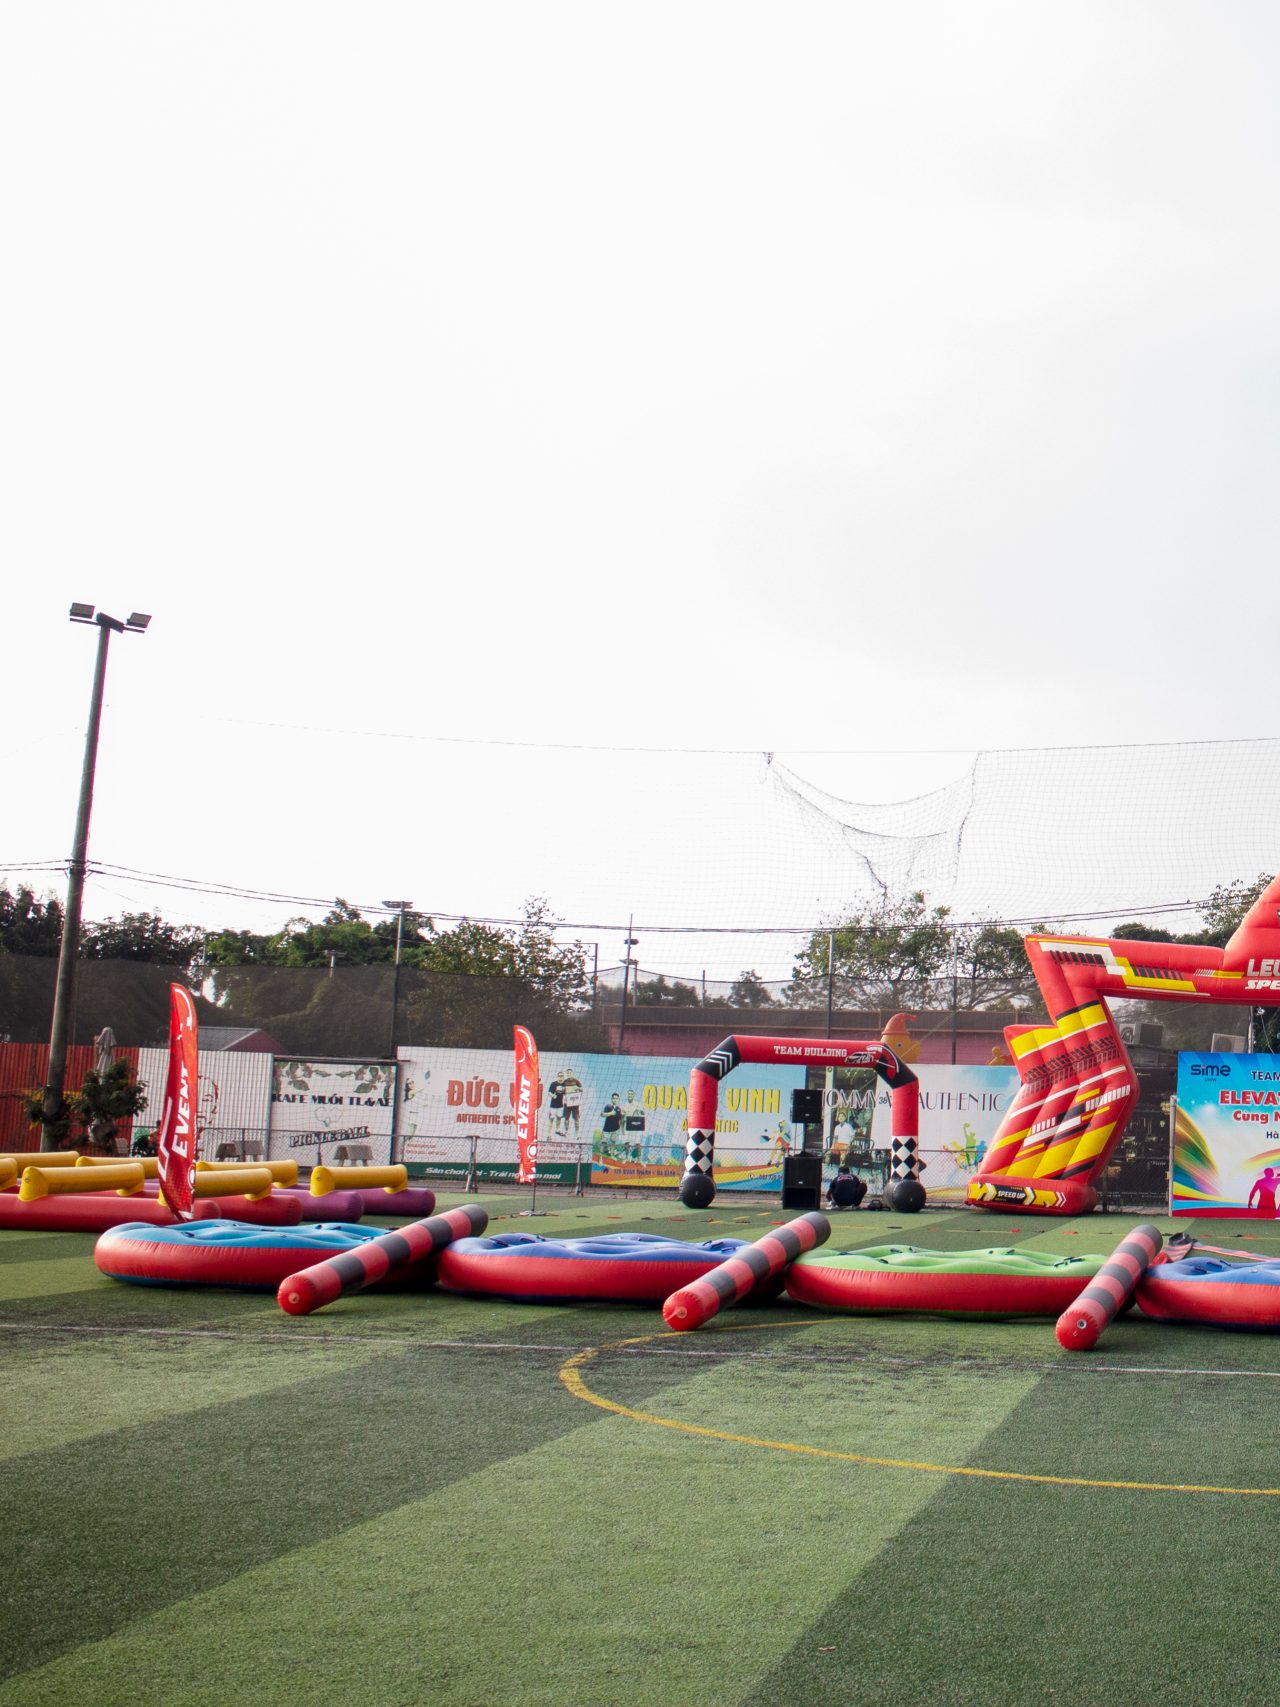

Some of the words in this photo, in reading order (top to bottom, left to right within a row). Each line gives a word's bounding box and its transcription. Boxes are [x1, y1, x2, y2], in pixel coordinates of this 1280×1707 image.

[773, 1045, 802, 1055] TEAM
[804, 1047, 848, 1057] BUILDING
[447, 1075, 500, 1108] ĐỨC
[642, 1084, 688, 1111] QUA
[726, 1088, 781, 1113] VINH
[171, 1061, 189, 1159] EVENT
[517, 1074, 531, 1140] EVENT
[918, 1091, 1006, 1112] AUTHENTIC
[456, 1113, 501, 1125] AUTHENTIC
[1232, 1110, 1269, 1125] Cùng
[1266, 1131, 1280, 1139] Hà
[997, 1190, 1017, 1199] SPEED
[1016, 1192, 1026, 1200] UP
